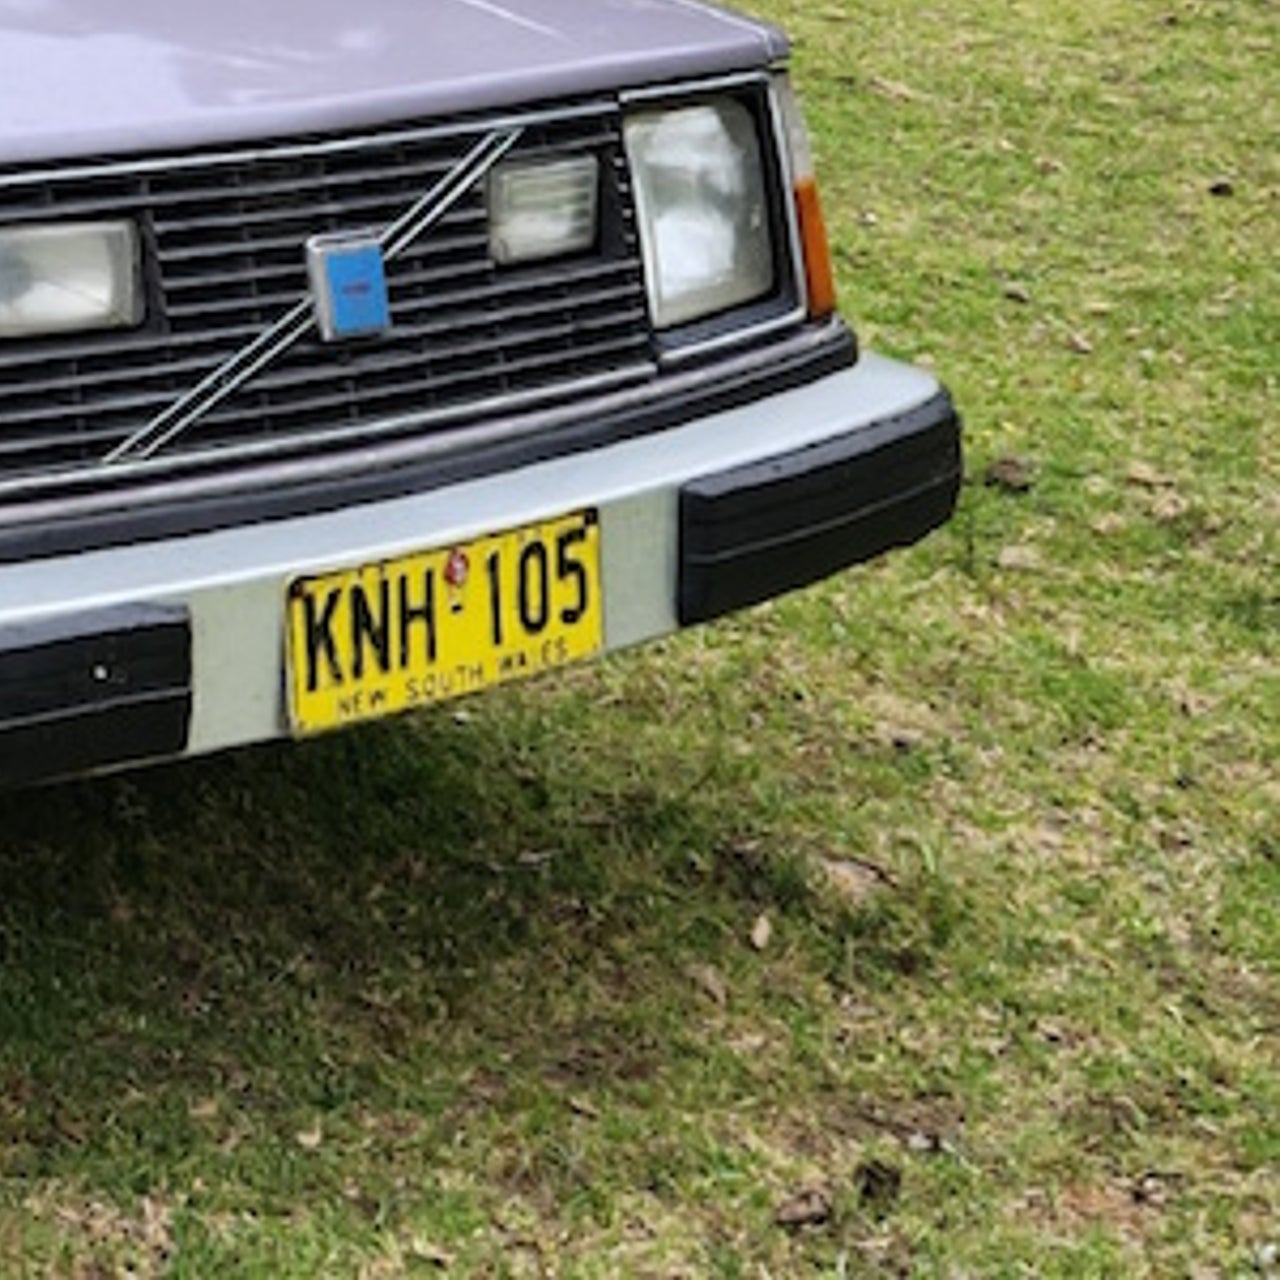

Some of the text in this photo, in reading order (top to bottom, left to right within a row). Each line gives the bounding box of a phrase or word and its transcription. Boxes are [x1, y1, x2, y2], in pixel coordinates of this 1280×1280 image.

[341, 637, 569, 715] NEW SOUTH WAES
